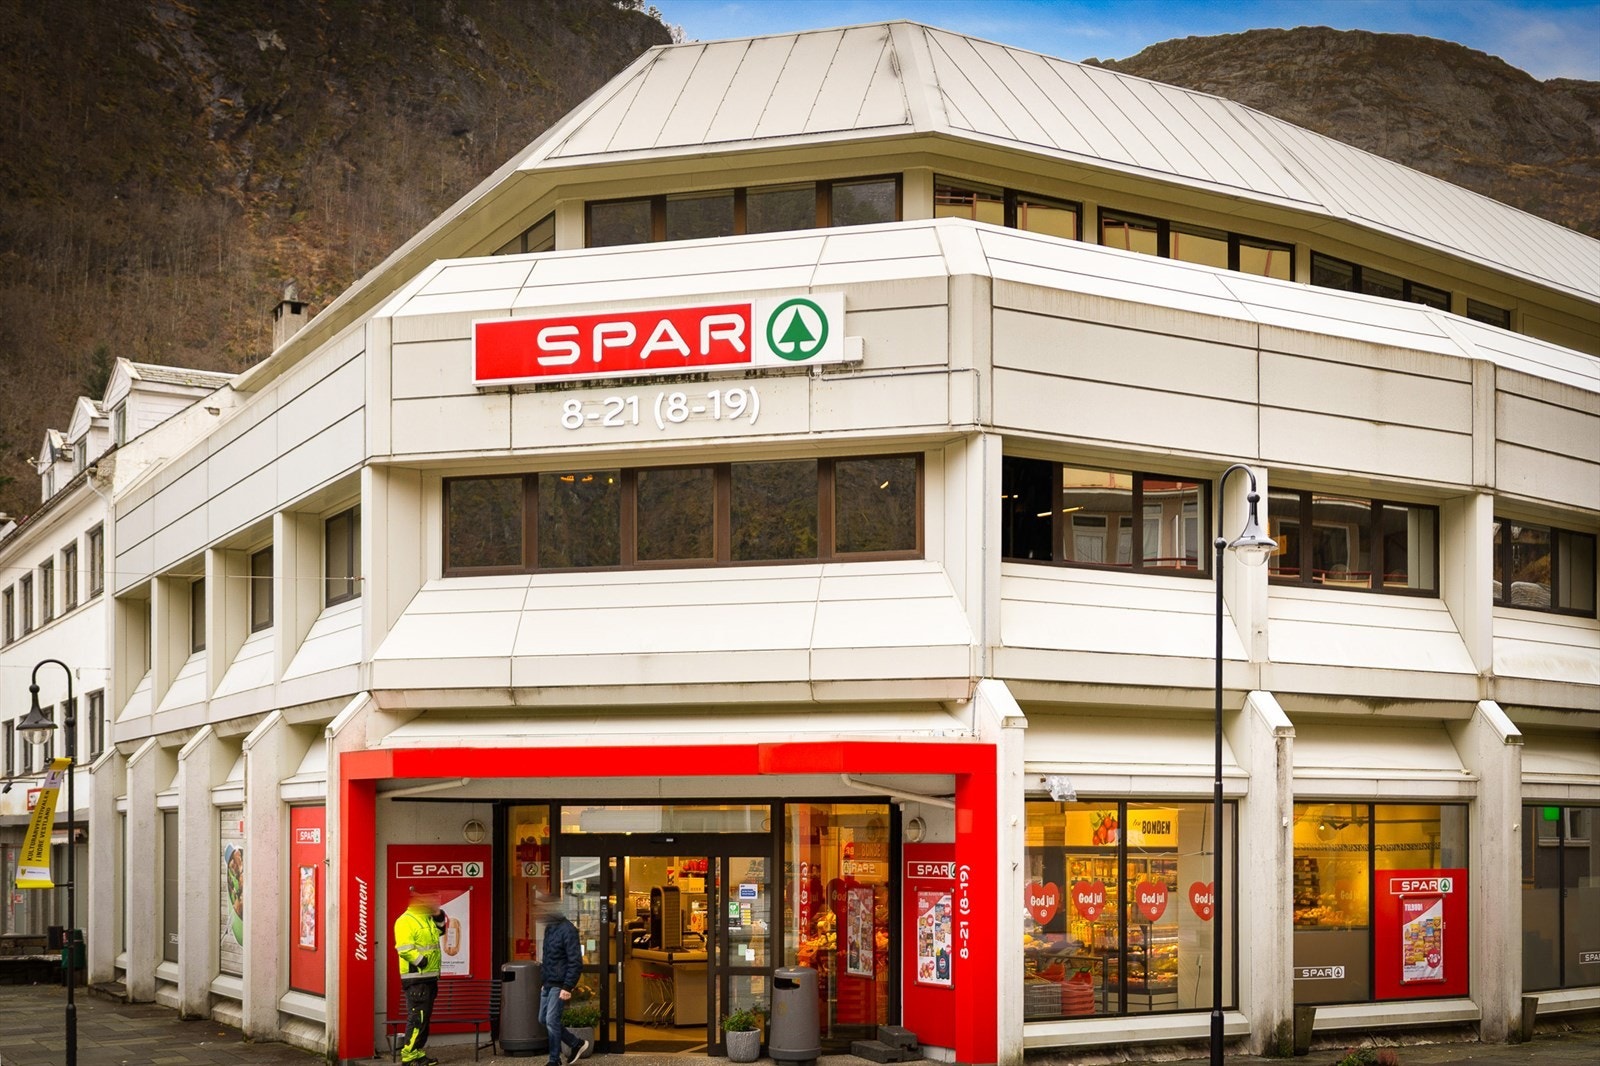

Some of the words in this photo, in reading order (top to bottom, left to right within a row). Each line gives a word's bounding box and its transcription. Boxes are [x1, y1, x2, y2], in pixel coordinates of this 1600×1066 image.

[537, 313, 746, 367] SPAR
[561, 395, 639, 430] 8-21
[654, 386, 761, 430] (8-19)
[40, 807, 51, 839] VESTLAND
[1142, 820, 1170, 835] BONDEN
[300, 831, 315, 841] SPAR
[413, 865, 463, 875] SPAR
[917, 865, 948, 875] SPAR
[960, 865, 970, 915] (8-19)
[1402, 881, 1438, 891] SPAR
[1031, 896, 1045, 906] God
[1046, 894, 1055, 907] jul
[1078, 892, 1092, 904] God
[1093, 893, 1102, 905] jul
[1141, 892, 1156, 904] God
[1156, 892, 1165, 905] jul
[1194, 893, 1208, 904] God
[354, 877, 368, 961] Velkommen!
[960, 921, 969, 959] 8-21
[1302, 969, 1332, 977] SPAR
